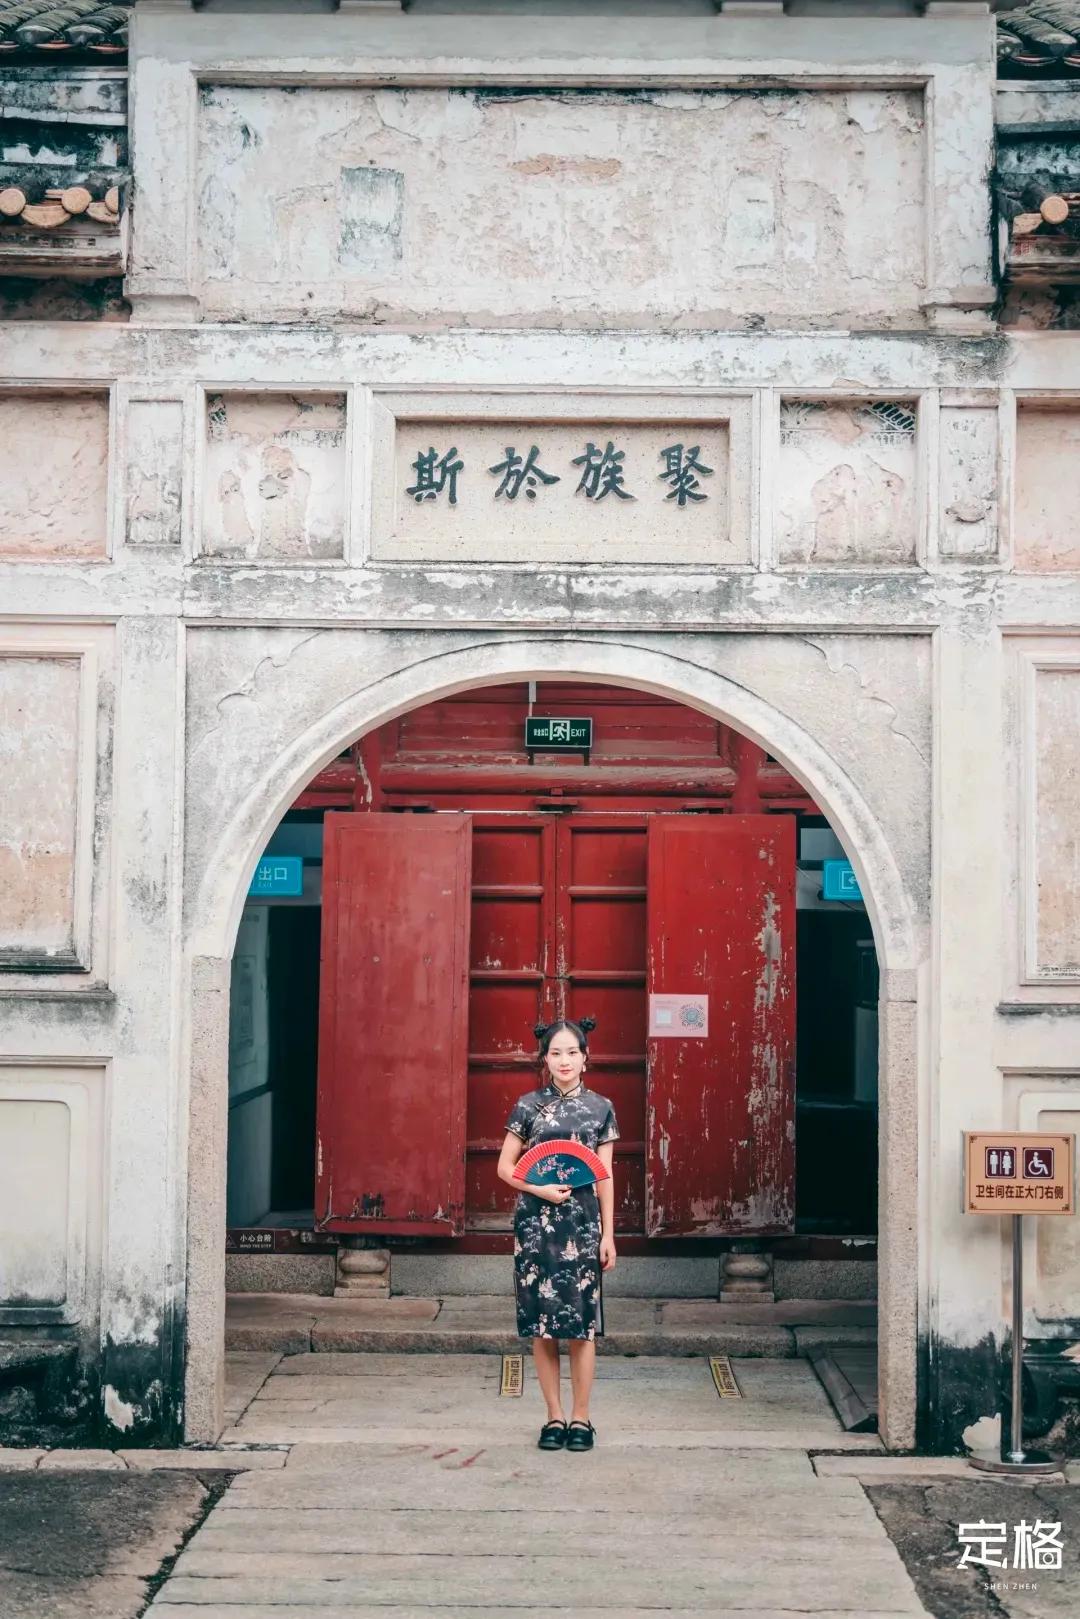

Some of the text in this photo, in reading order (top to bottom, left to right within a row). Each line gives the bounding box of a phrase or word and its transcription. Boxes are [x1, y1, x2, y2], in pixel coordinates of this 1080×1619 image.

[571, 729, 586, 737] EXIT
[259, 866, 287, 880] 出口
[976, 1185, 1064, 1199] 卫生间在正大门右侧
[240, 1233, 272, 1242] 小心台阶
